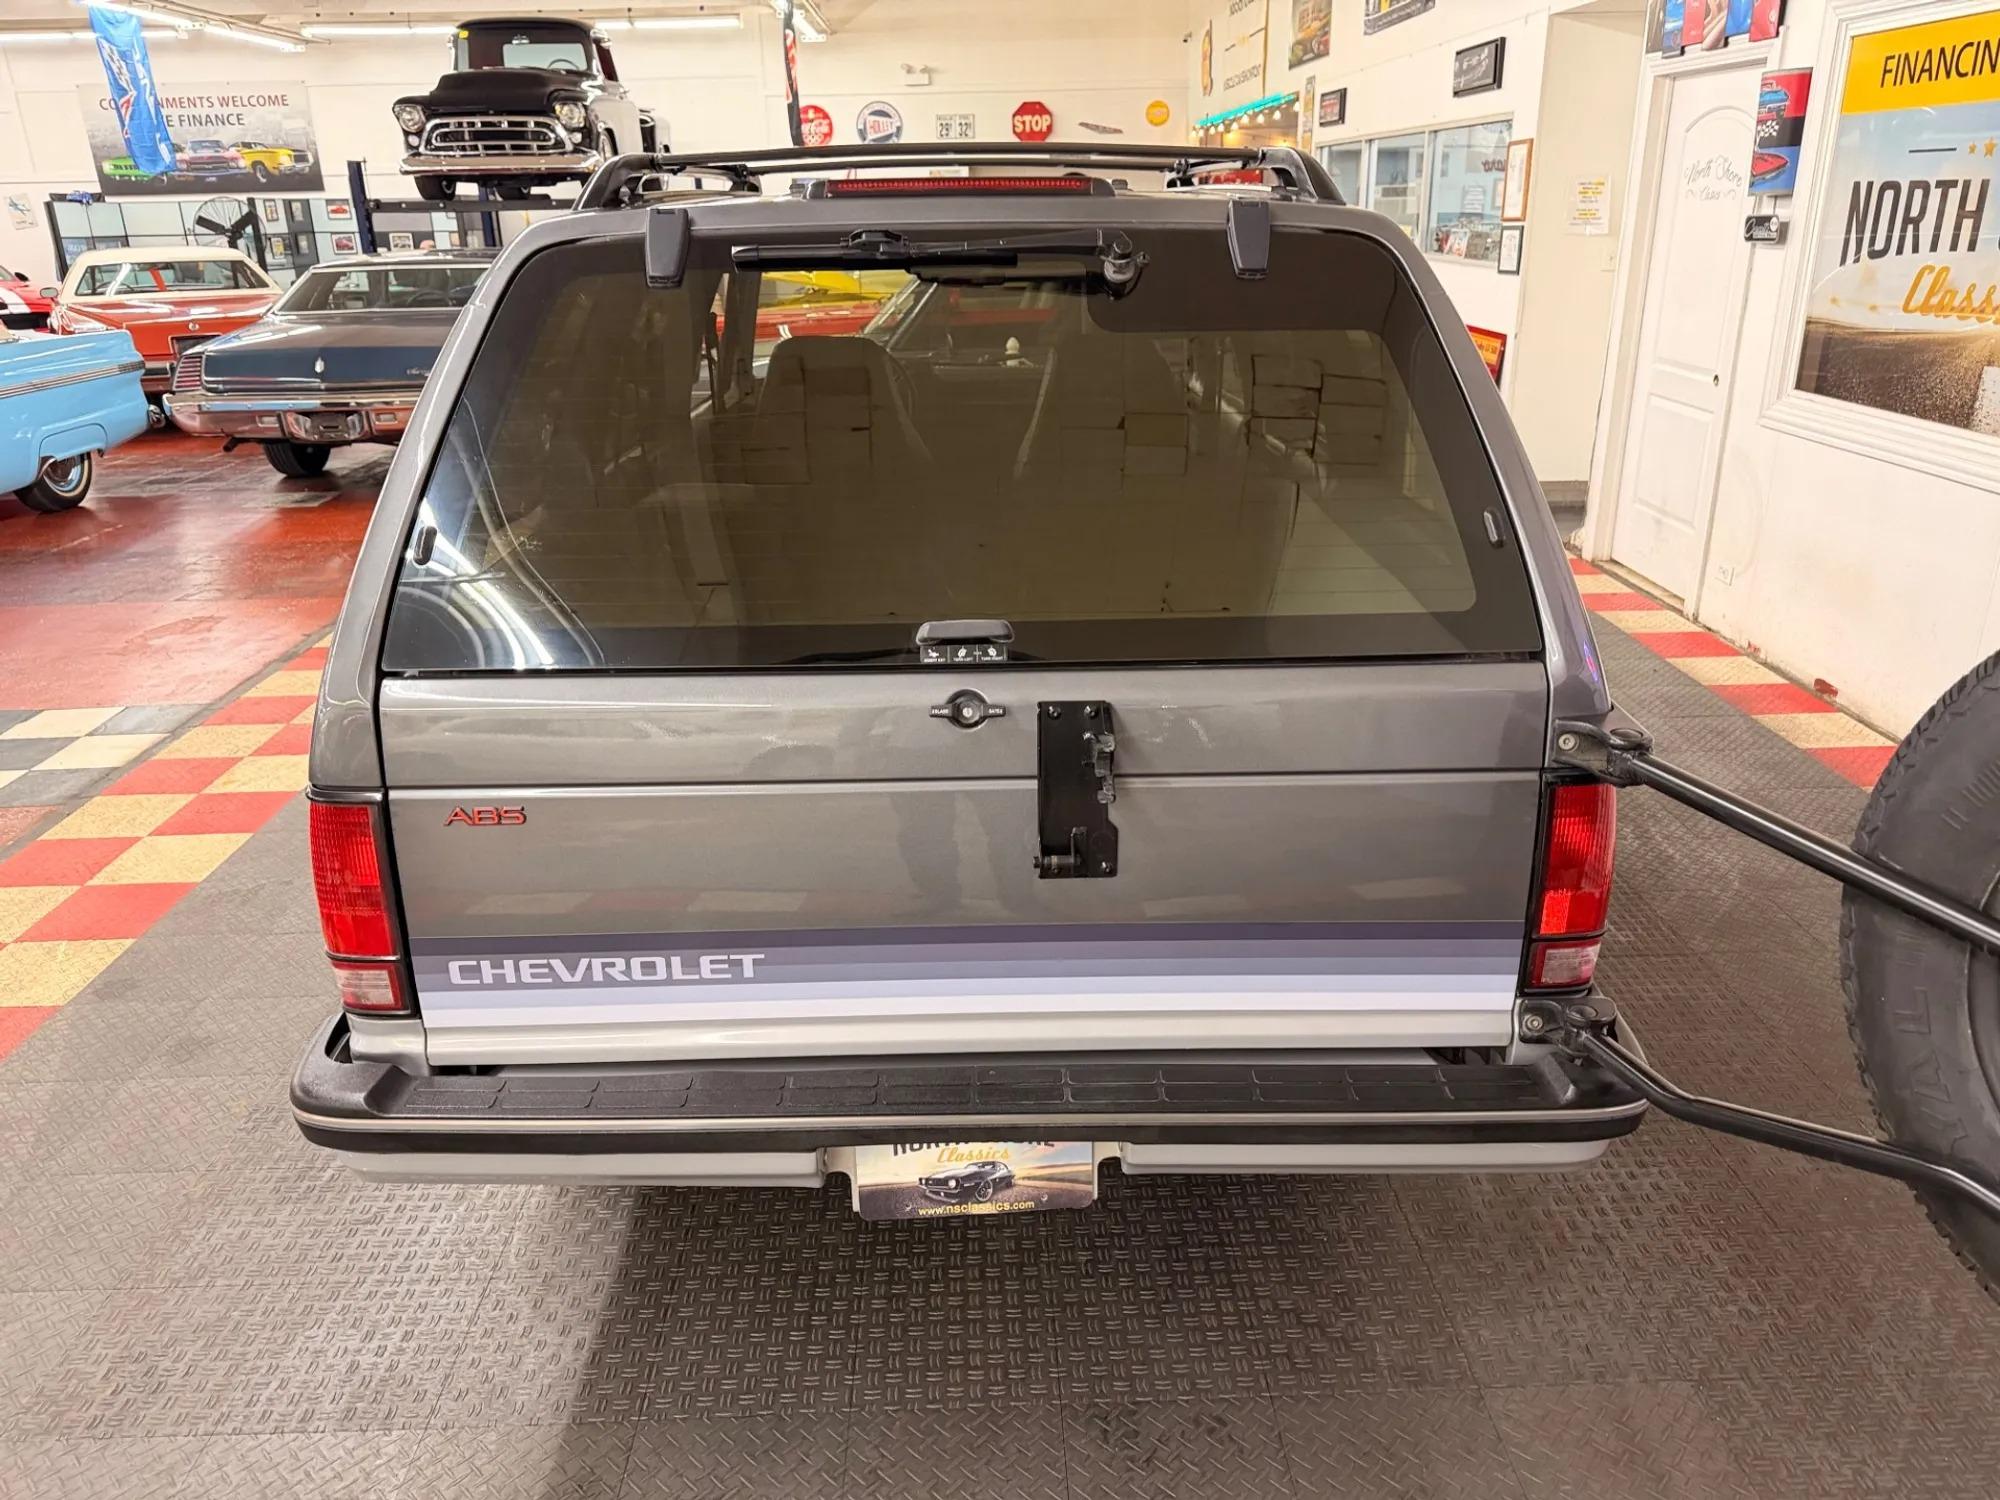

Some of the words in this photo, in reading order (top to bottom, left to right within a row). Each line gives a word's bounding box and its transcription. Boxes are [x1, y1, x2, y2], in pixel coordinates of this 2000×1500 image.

[217, 94, 289, 108] WELCOME
[179, 113, 245, 128] FINANCE
[1013, 114, 1051, 133] STOP
[1840, 178, 1990, 267] NORTH
[1902, 264, 2000, 324] Class
[444, 806, 527, 826] ABS
[448, 953, 765, 985] CHEVROLET
[936, 1146, 1011, 1164] Classics
[918, 1200, 1035, 1216] www.nsclassics.com
